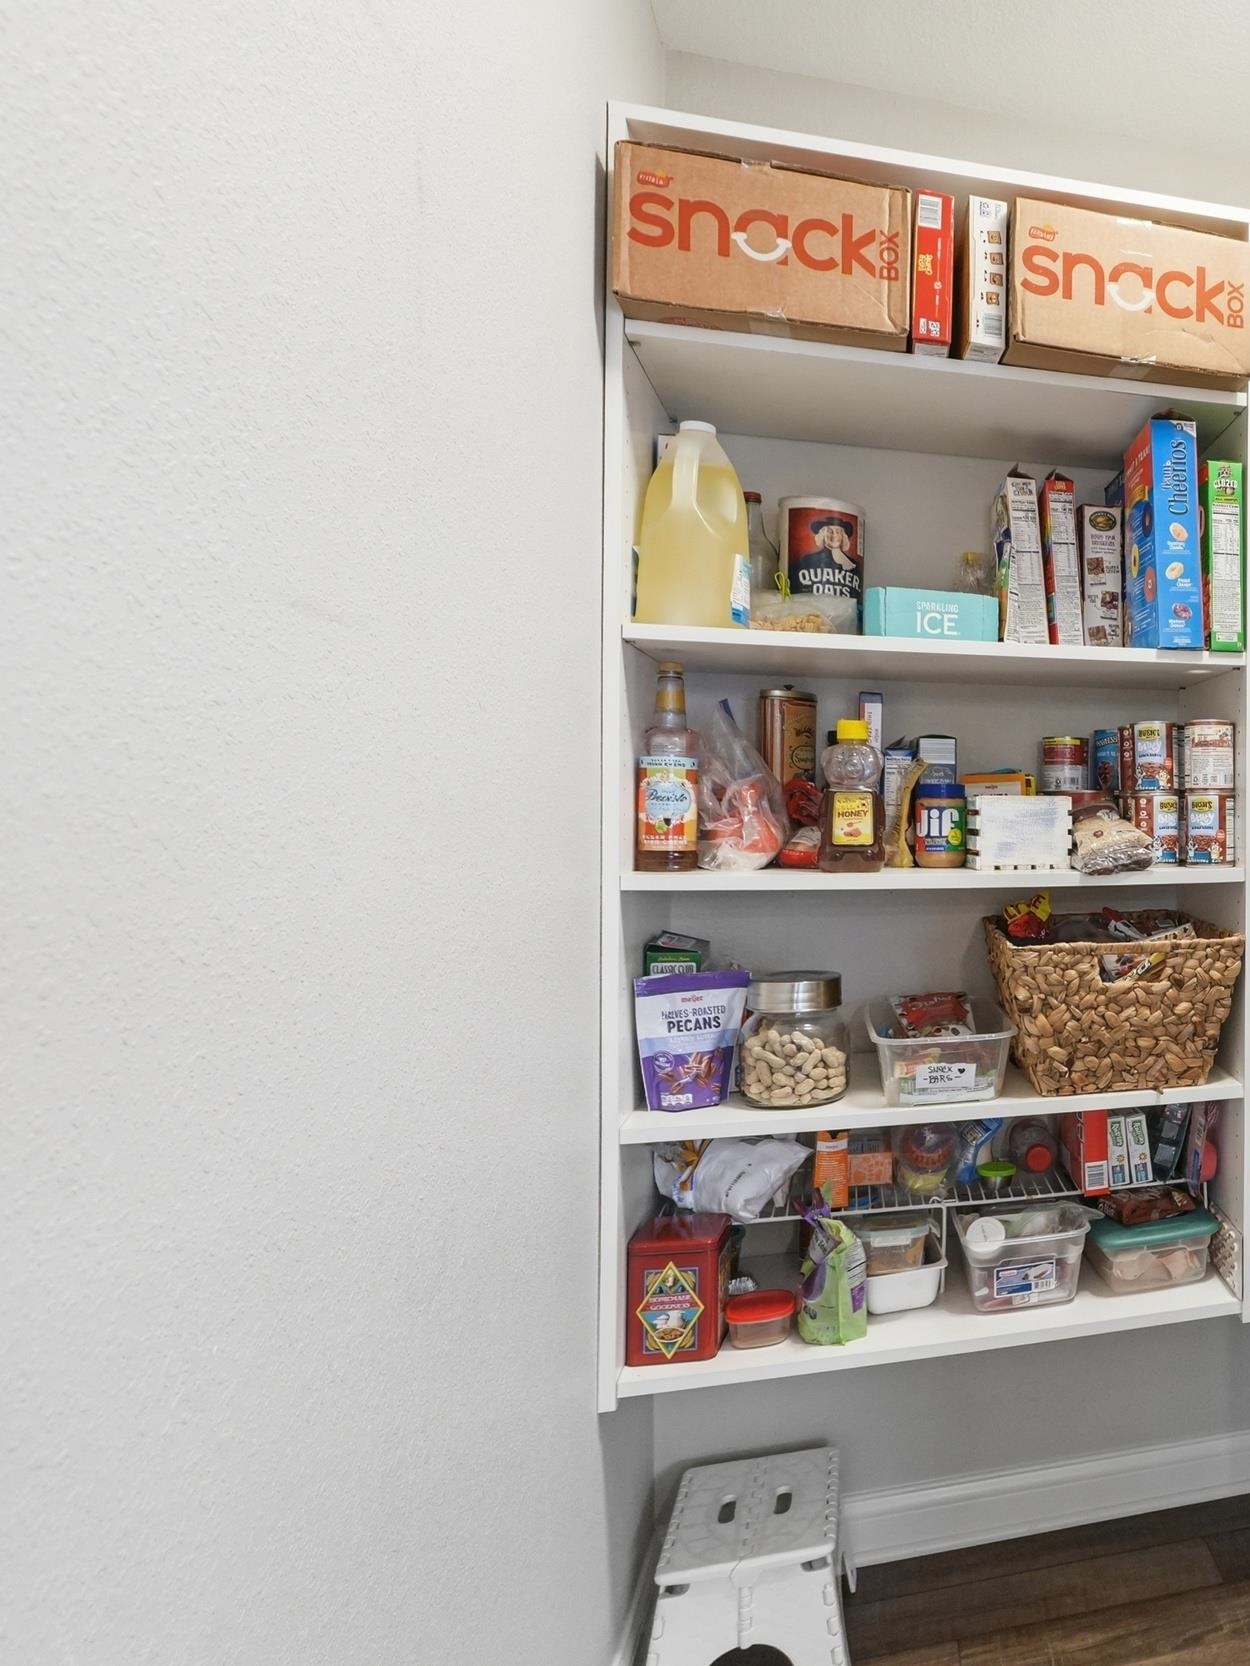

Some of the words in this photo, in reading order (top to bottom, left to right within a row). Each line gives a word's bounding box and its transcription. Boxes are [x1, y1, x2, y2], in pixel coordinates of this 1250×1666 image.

[627, 191, 876, 279] snack
[879, 230, 900, 281] BOX
[1020, 245, 1225, 326] snack
[1227, 280, 1244, 328] BOX
[1168, 440, 1189, 516] Cheerios
[799, 568, 861, 591] QUAKER
[813, 584, 851, 598] OATS
[916, 601, 959, 613] SPARKLING
[916, 613, 960, 636] ICE
[838, 810, 867, 818] HONEY
[667, 1015, 721, 1033] PECANS
